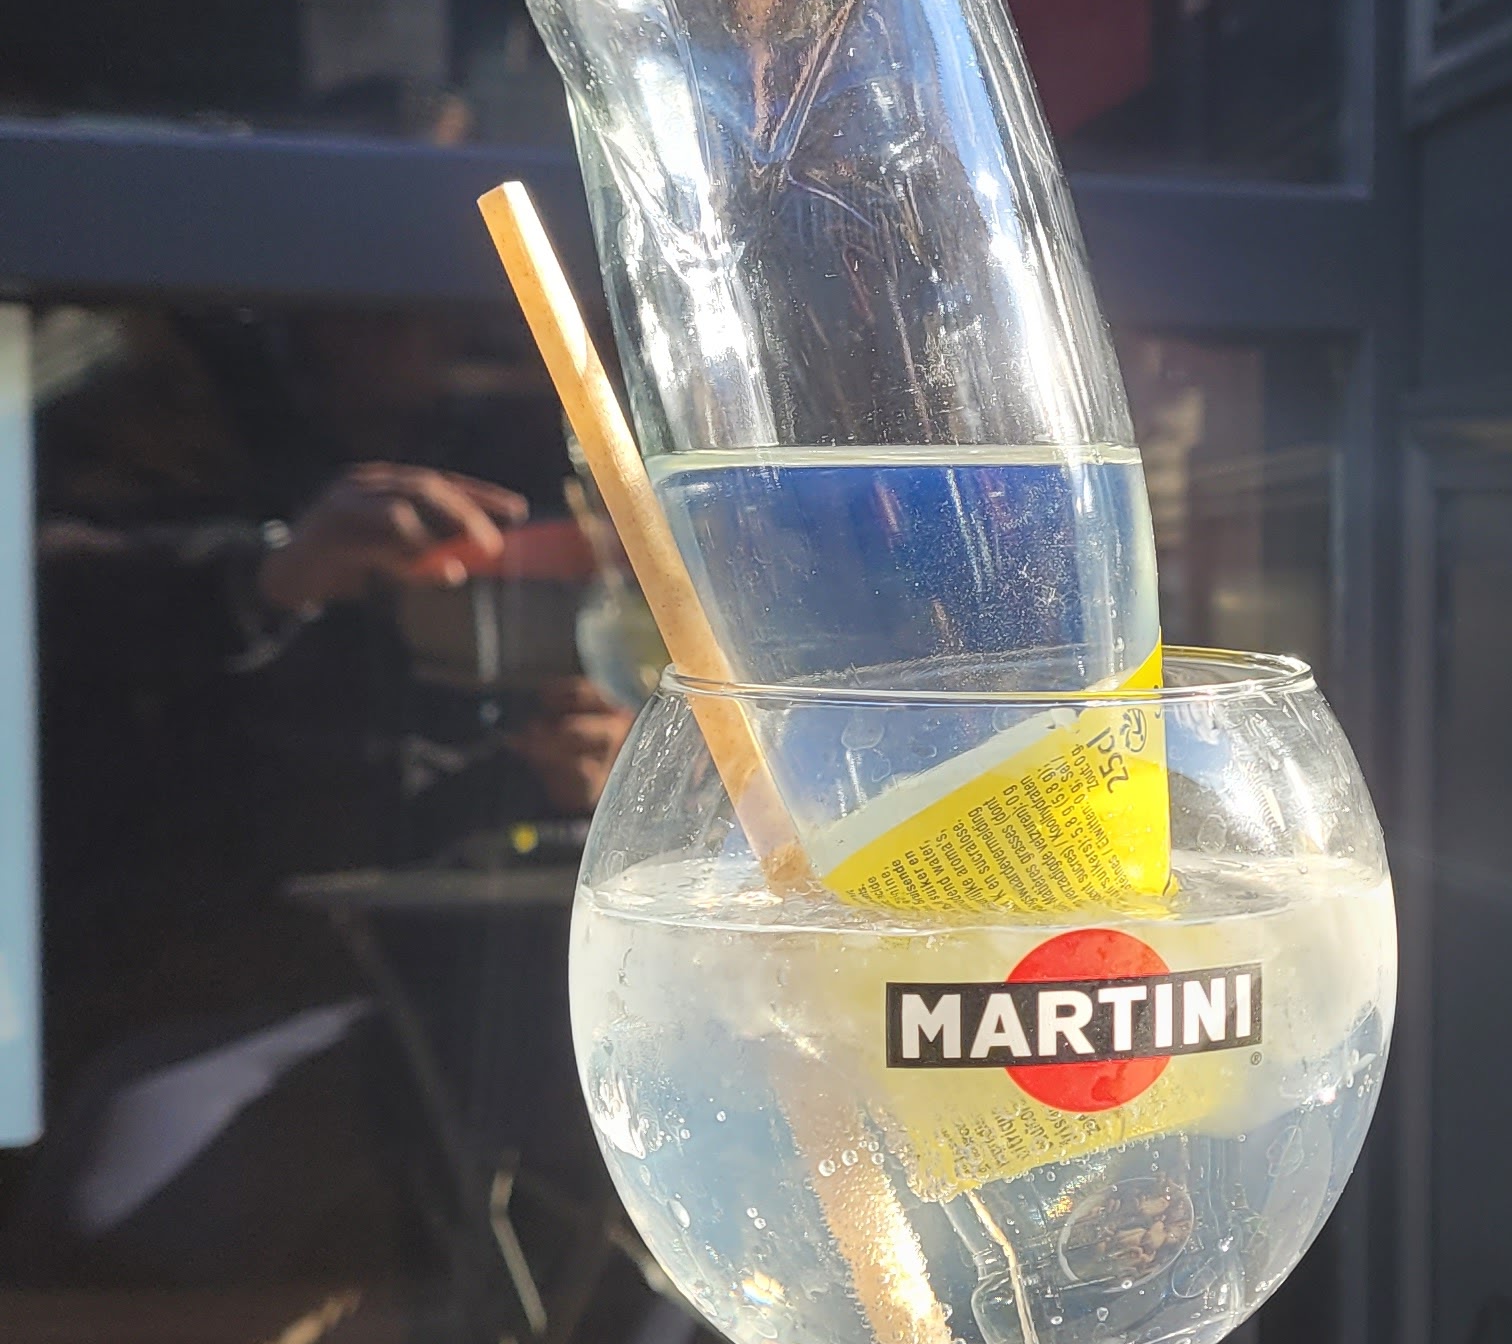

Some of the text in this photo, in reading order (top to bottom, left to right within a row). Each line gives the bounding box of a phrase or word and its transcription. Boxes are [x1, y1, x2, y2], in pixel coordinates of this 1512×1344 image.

[1075, 761, 1102, 792] Zout:
[980, 793, 1012, 827] (dont
[1008, 799, 1052, 856] vetzuren):
[1015, 772, 1067, 842] Koolhydraten
[1062, 814, 1087, 839] 5,8
[903, 848, 920, 867] en
[915, 838, 947, 878] water,
[929, 827, 971, 880] aroma's,
[946, 817, 991, 877] sucralose.
[999, 821, 1035, 866] grasses
[1057, 843, 1092, 885] sucres)
[910, 864, 940, 904] suiker
[981, 872, 1000, 891] en
[1020, 861, 1058, 909] Matières
[1037, 847, 1081, 905] verzadigde
[901, 972, 1252, 1060] MARTINI
